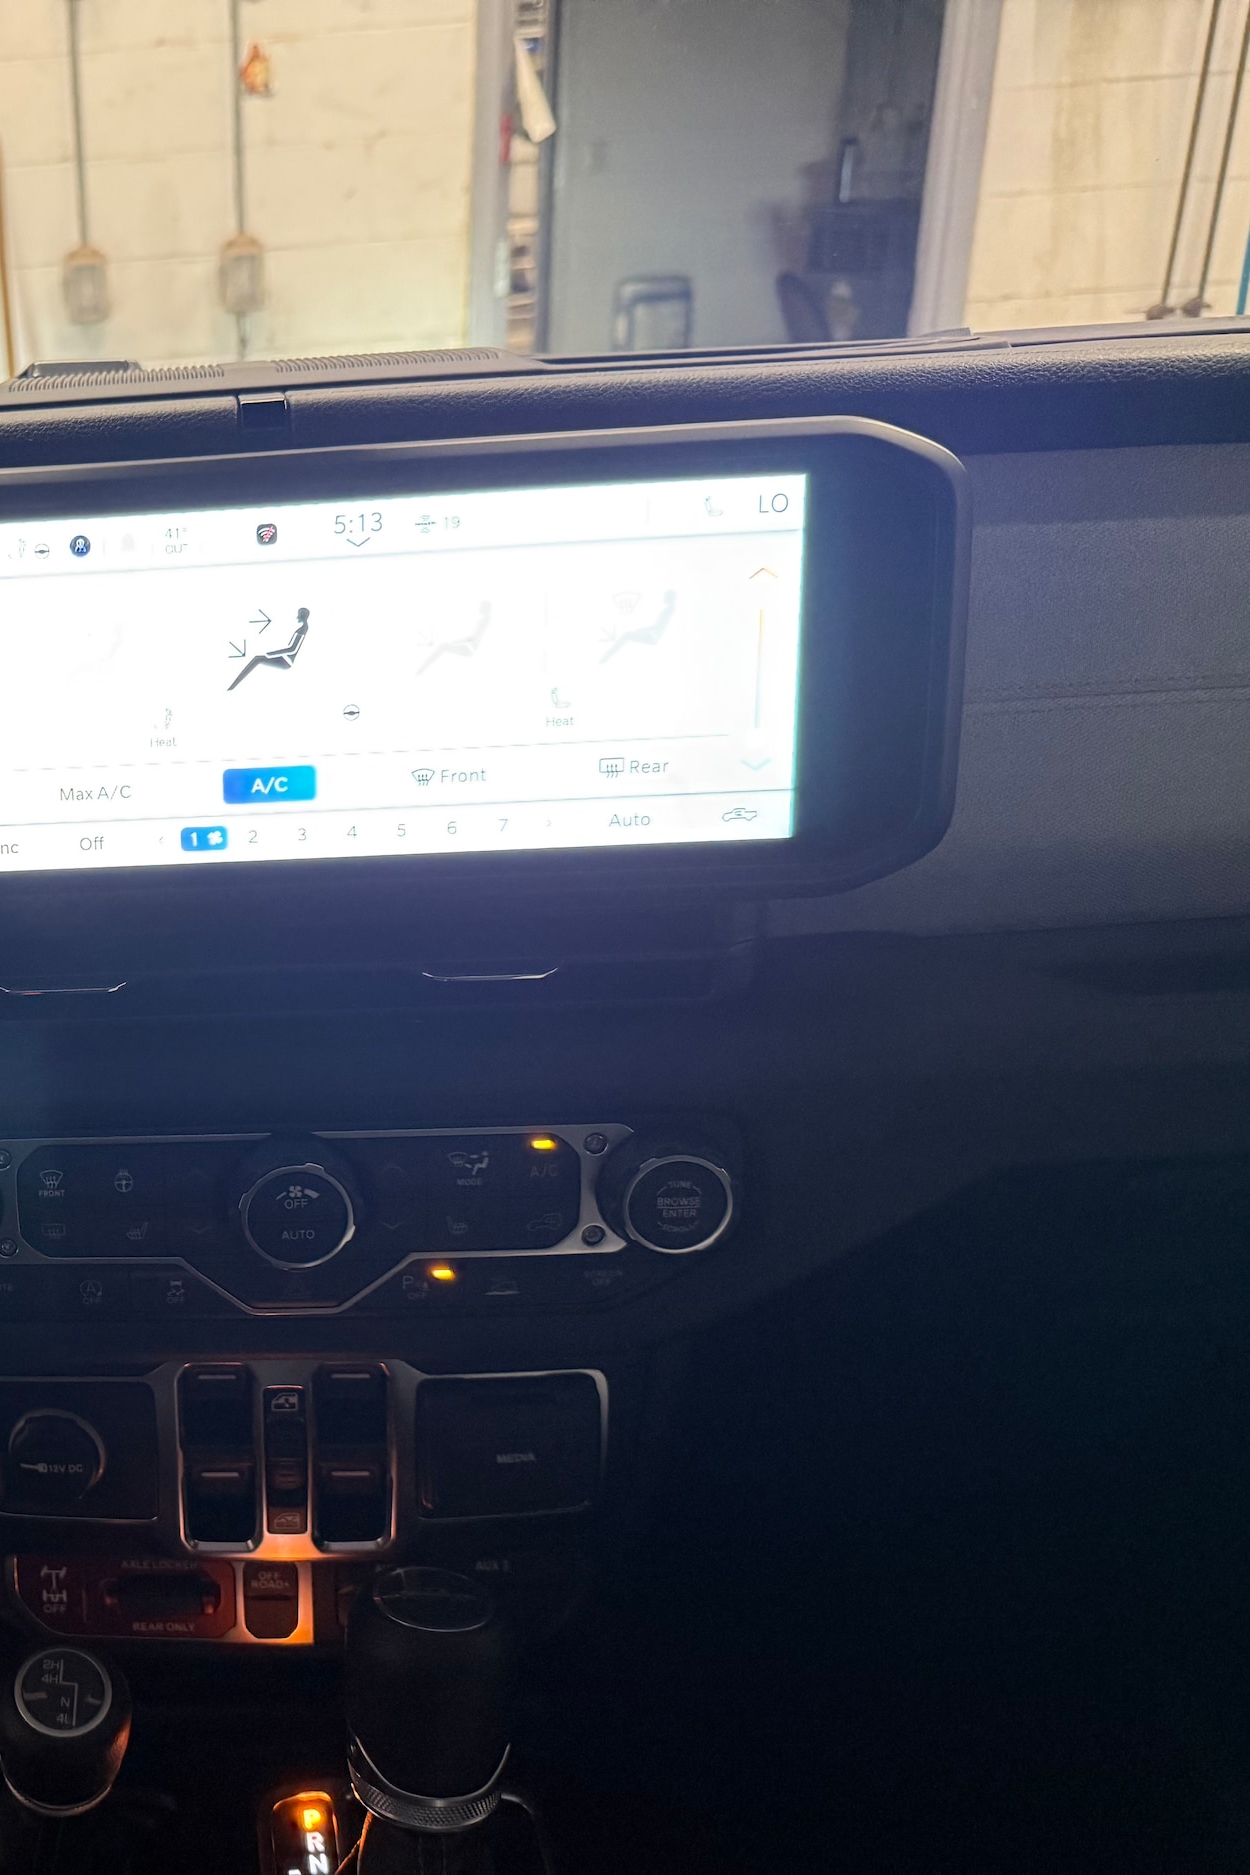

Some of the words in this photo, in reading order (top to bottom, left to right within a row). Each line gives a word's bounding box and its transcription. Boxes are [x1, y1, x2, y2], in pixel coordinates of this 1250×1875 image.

[759, 493, 789, 514] LO
[333, 512, 383, 535] 5:13
[444, 516, 461, 529] 19
[545, 716, 574, 728] Heat
[630, 760, 669, 774] Rear
[440, 768, 487, 784] Front
[251, 776, 289, 795] A/C
[59, 787, 94, 802] Max
[97, 785, 131, 801] A/C
[608, 813, 651, 827] Auto
[249, 829, 258, 845] 2
[298, 827, 307, 842] 3
[347, 825, 357, 839] 4
[396, 823, 406, 838] 5
[447, 821, 457, 835] 6
[498, 819, 509, 832] 7
[79, 836, 104, 851] Off
[530, 1164, 559, 1178] A/C
[456, 1177, 483, 1186] MODE
[38, 1189, 65, 1198] FRONT
[284, 1199, 308, 1209] OFF
[657, 1197, 701, 1207] BROWSE
[662, 1209, 696, 1218] ENTER
[282, 1230, 315, 1240] AUTO
[257, 1571, 280, 1580] OFF
[43, 1604, 66, 1614] OFF
[132, 1621, 163, 1631] REAR
[165, 1622, 195, 1632] ONLY
[43, 1659, 59, 1670] 2H
[41, 1673, 58, 1684] 4H
[60, 1697, 70, 1707] N
[56, 1713, 70, 1724] 4L
[303, 1808, 321, 1830] P
[306, 1831, 325, 1852] R
[308, 1853, 329, 1875] N
